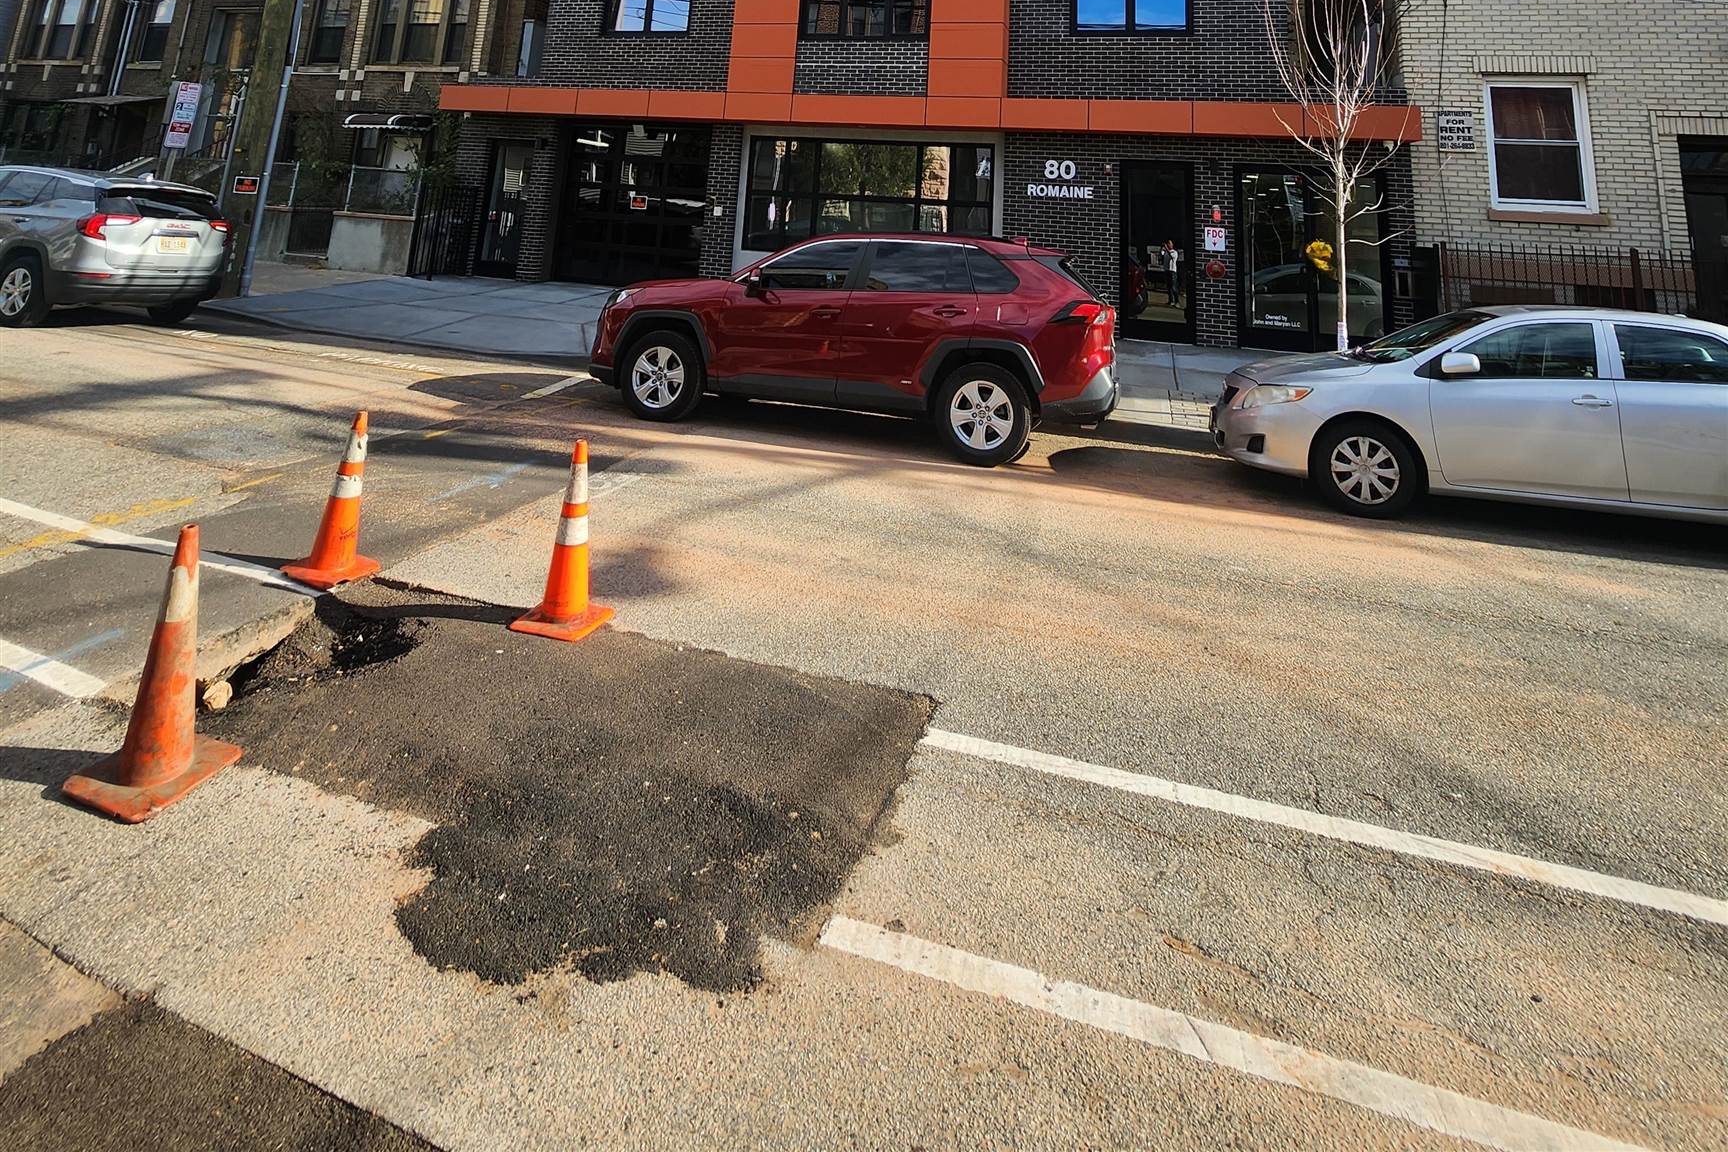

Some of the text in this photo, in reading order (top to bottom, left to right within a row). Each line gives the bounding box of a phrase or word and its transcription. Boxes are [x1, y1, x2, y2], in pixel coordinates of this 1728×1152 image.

[1440, 126, 1472, 134] RENT
[1044, 159, 1076, 179] 80
[1027, 183, 1094, 199] ROMAINE
[1206, 229, 1223, 238] FDC
[1265, 313, 1281, 321] Owned
